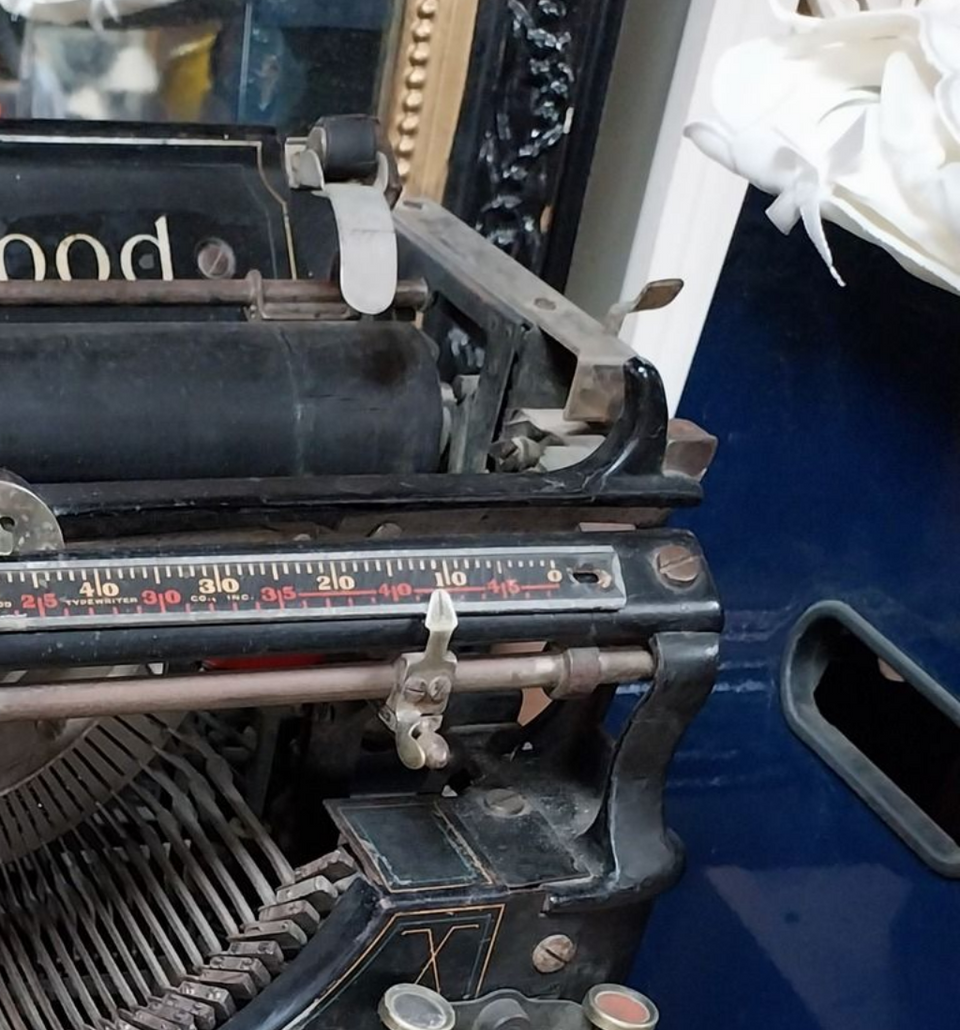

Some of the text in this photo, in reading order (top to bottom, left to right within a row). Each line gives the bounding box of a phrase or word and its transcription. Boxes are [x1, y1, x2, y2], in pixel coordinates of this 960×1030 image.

[79, 582, 120, 597] 40
[198, 578, 240, 594] 30
[316, 574, 355, 591] 20
[548, 568, 562, 583] 0
[20, 592, 59, 609] 25
[141, 589, 181, 605] 30
[260, 585, 296, 601] 35
[65, 597, 138, 607] TYPEWRITER
